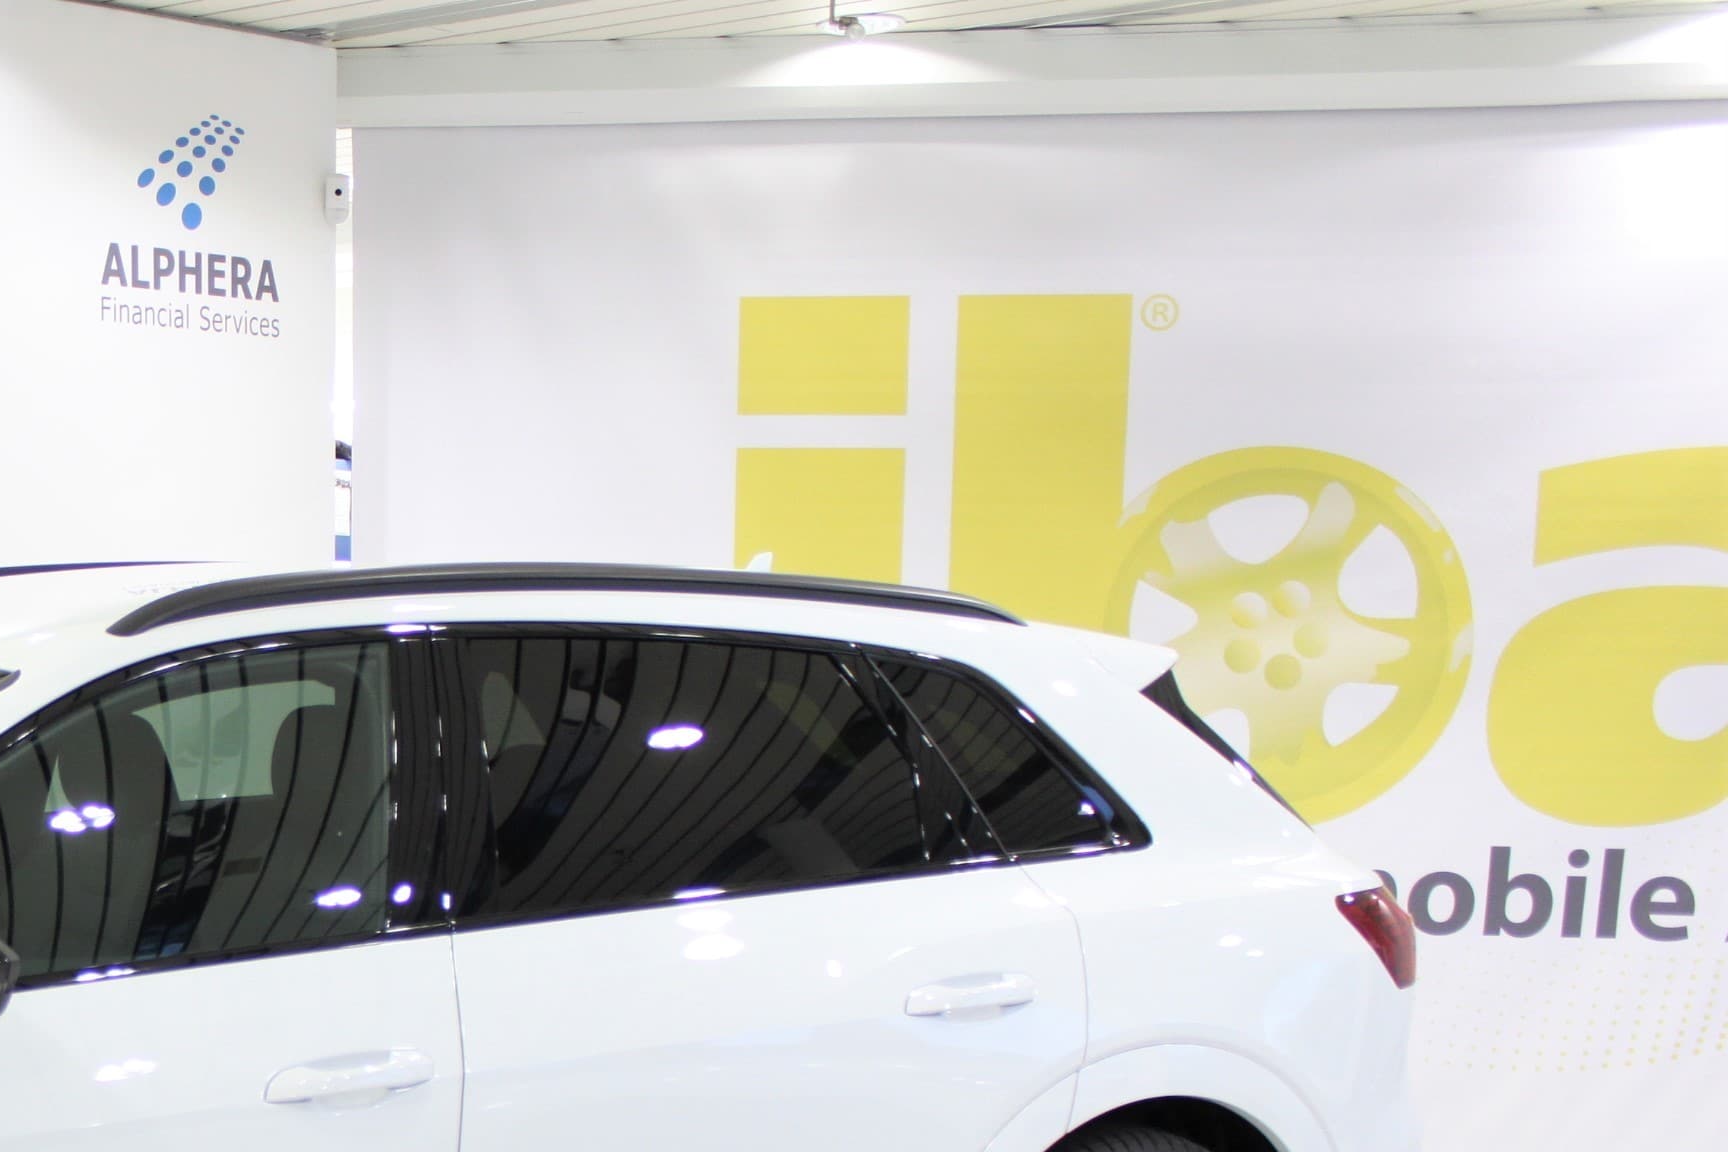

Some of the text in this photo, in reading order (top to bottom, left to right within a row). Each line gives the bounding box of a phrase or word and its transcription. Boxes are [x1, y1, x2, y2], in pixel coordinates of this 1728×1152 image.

[101, 242, 280, 303] ALPHERA
[100, 296, 280, 338] Financial Services
[1373, 845, 1696, 942] obile
